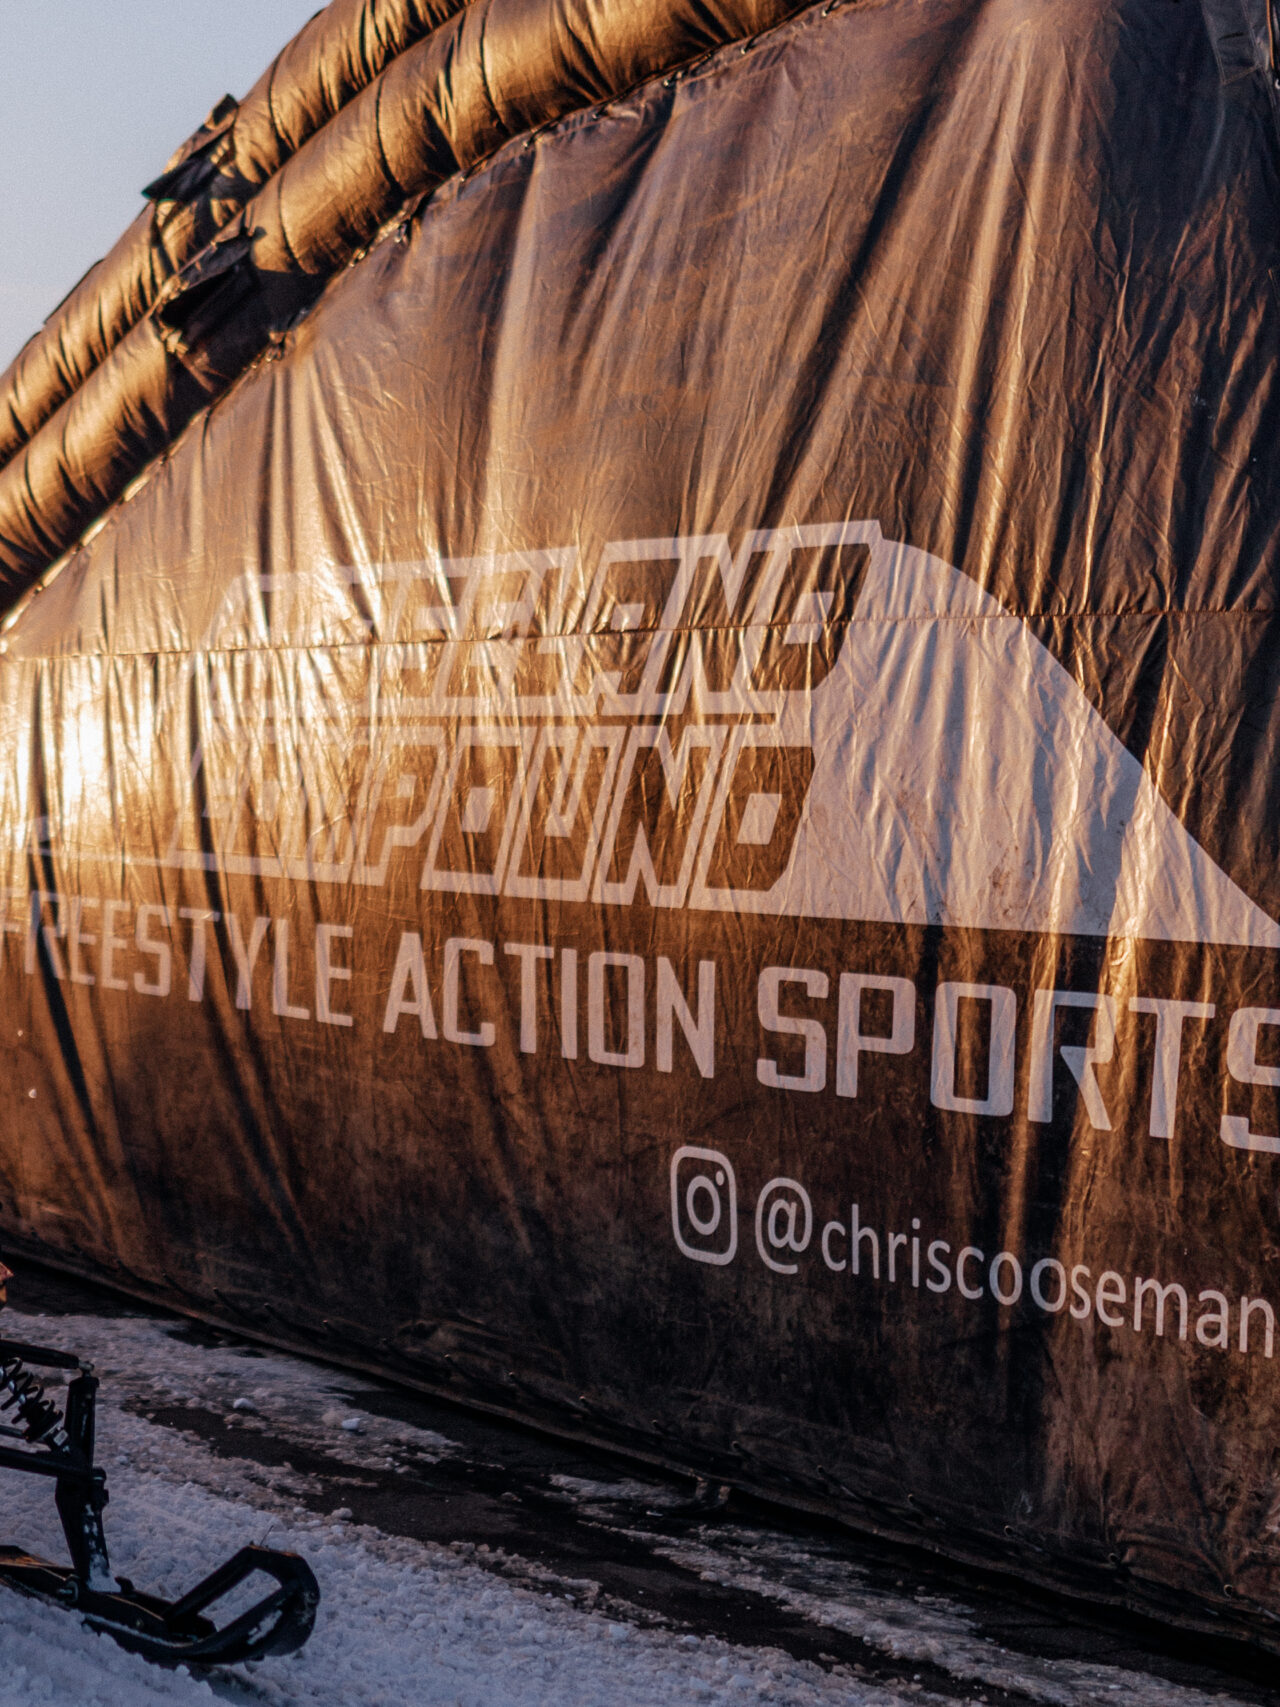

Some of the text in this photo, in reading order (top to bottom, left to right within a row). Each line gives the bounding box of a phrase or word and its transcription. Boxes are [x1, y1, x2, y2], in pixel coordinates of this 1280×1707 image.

[382, 931, 716, 1079] ACTION
[756, 965, 1280, 1154] SPORTS
[755, 1177, 1275, 1359] @chriscooseman
